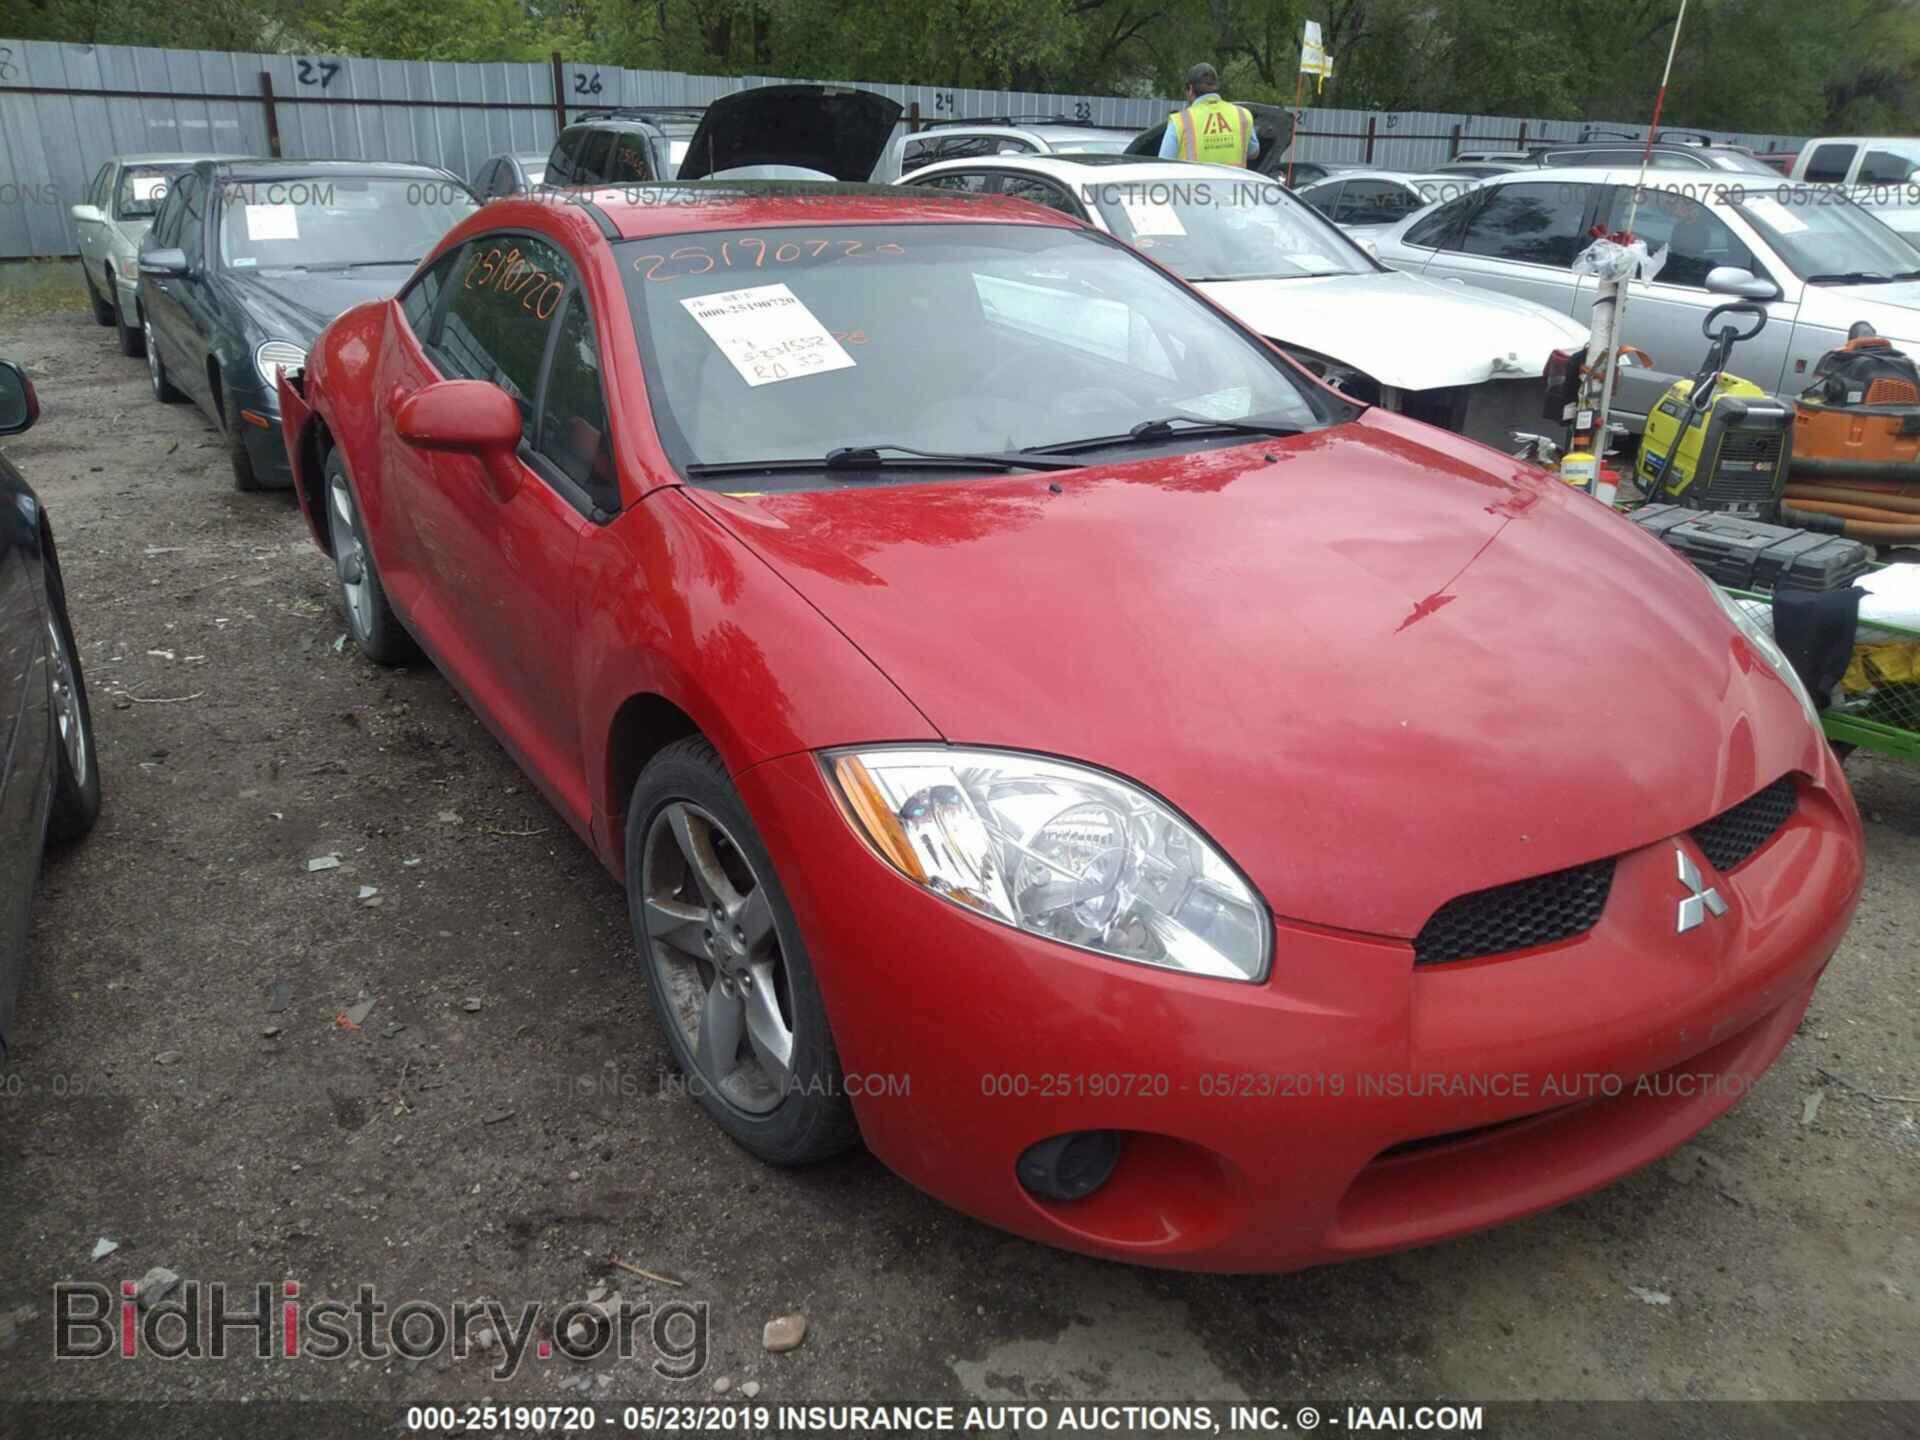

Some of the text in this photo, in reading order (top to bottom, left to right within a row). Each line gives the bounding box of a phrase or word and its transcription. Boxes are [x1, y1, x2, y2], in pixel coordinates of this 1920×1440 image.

[297, 60, 341, 88] 27
[574, 71, 603, 95] 26
[935, 93, 954, 113] 24
[634, 238, 905, 281] 25190720
[464, 248, 564, 320] 25190720
